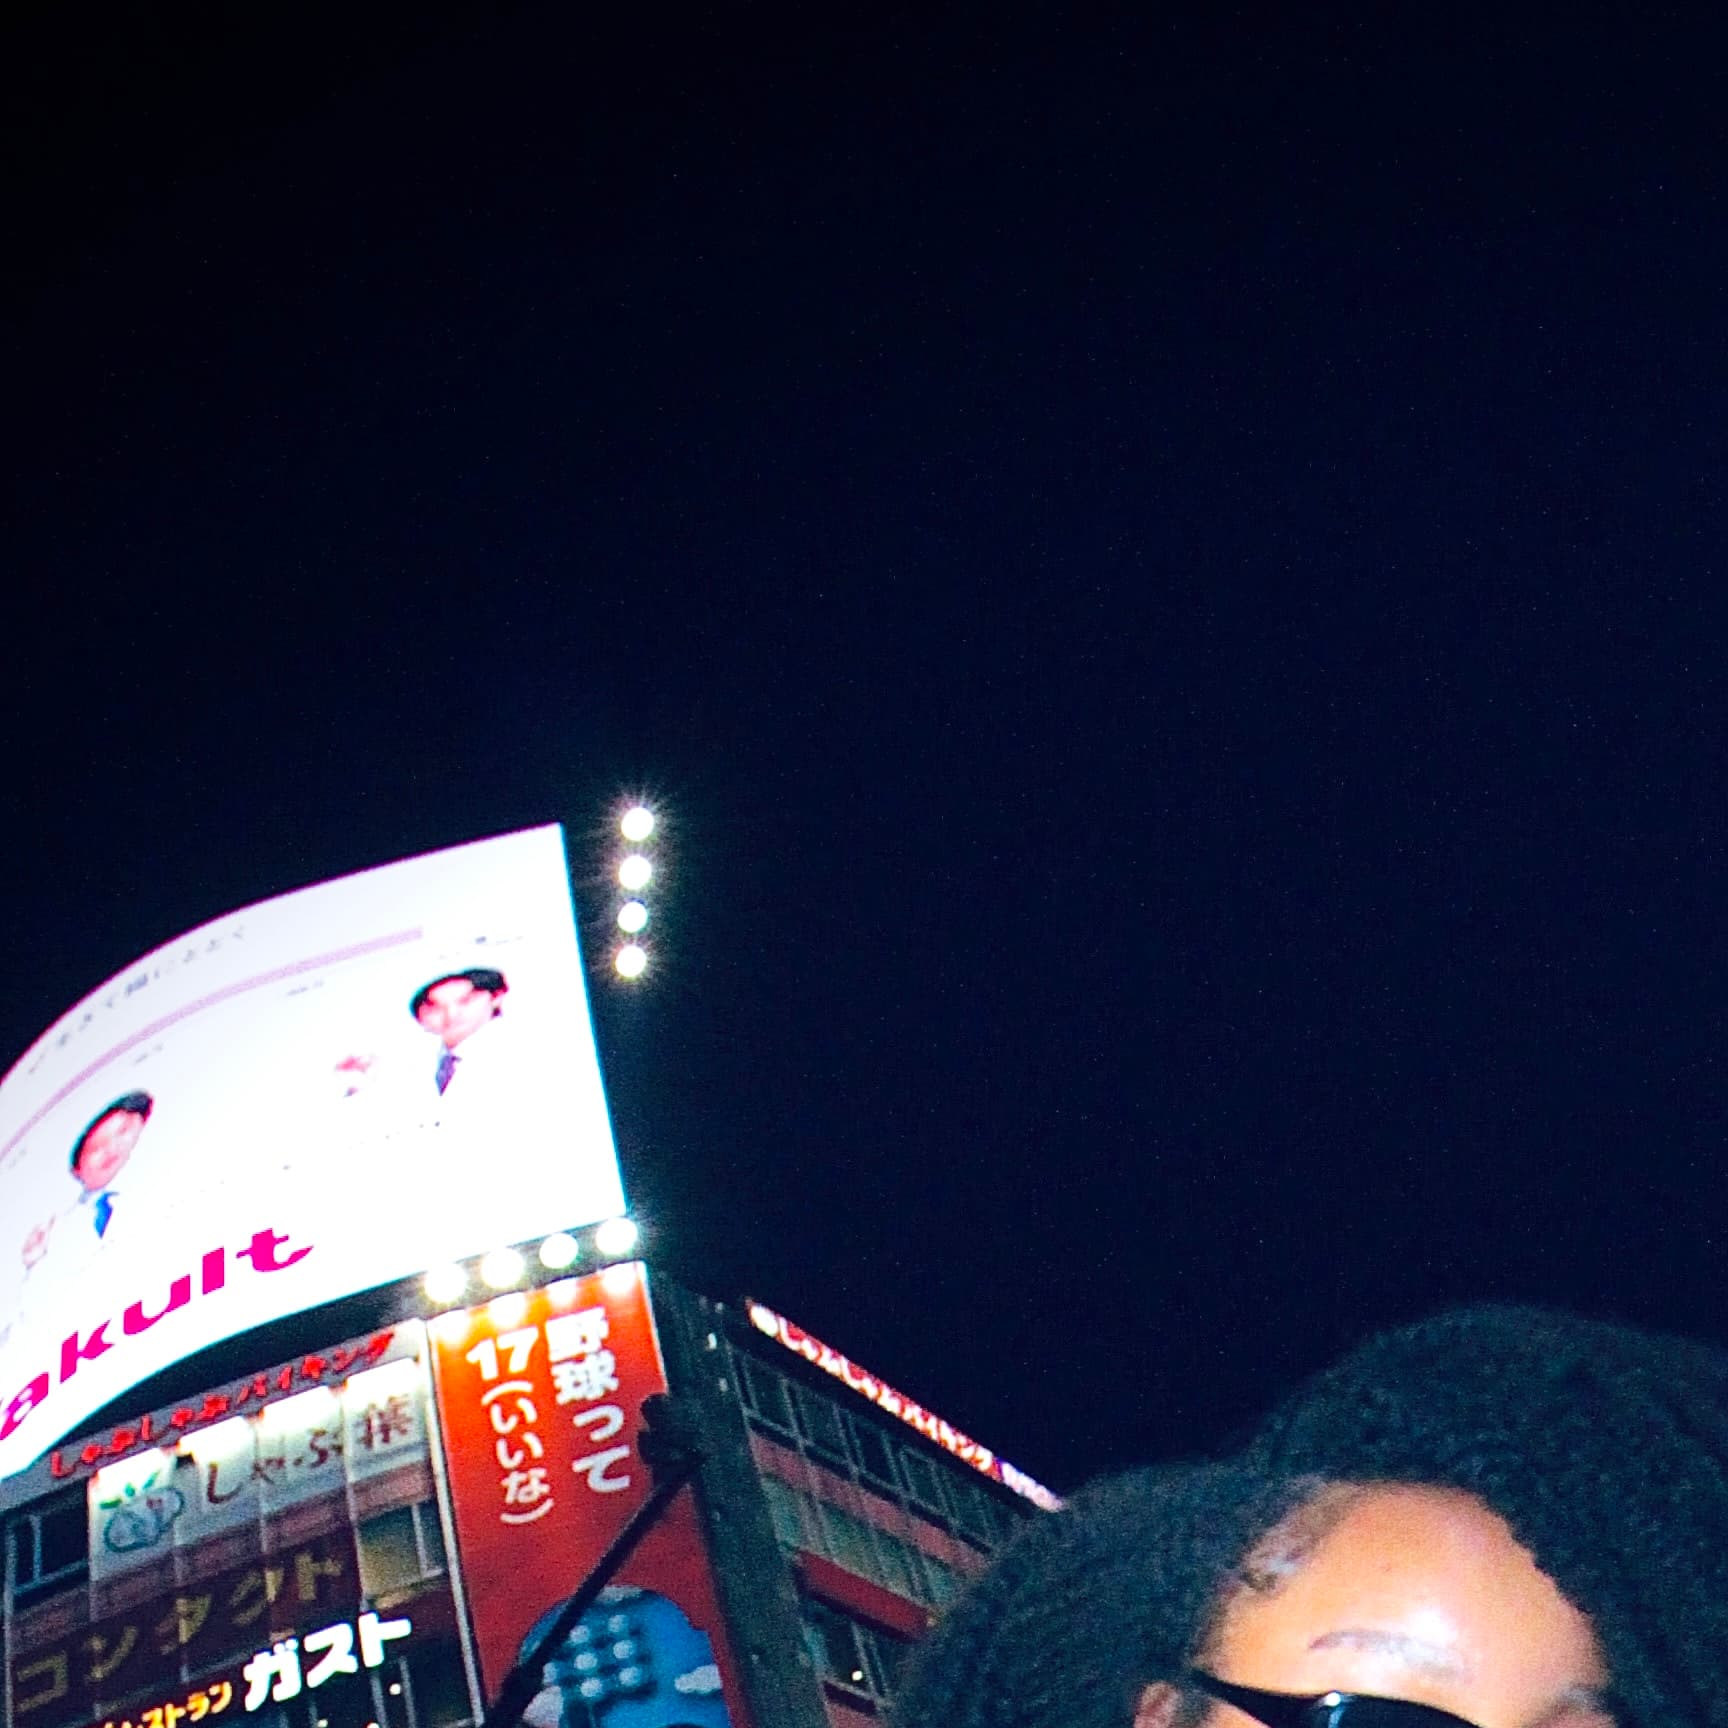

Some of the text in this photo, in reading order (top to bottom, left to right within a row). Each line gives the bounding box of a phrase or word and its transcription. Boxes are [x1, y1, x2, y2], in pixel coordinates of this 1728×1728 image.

[544, 1305, 632, 1496] 野球って
[242, 1609, 412, 1712] ガスト
